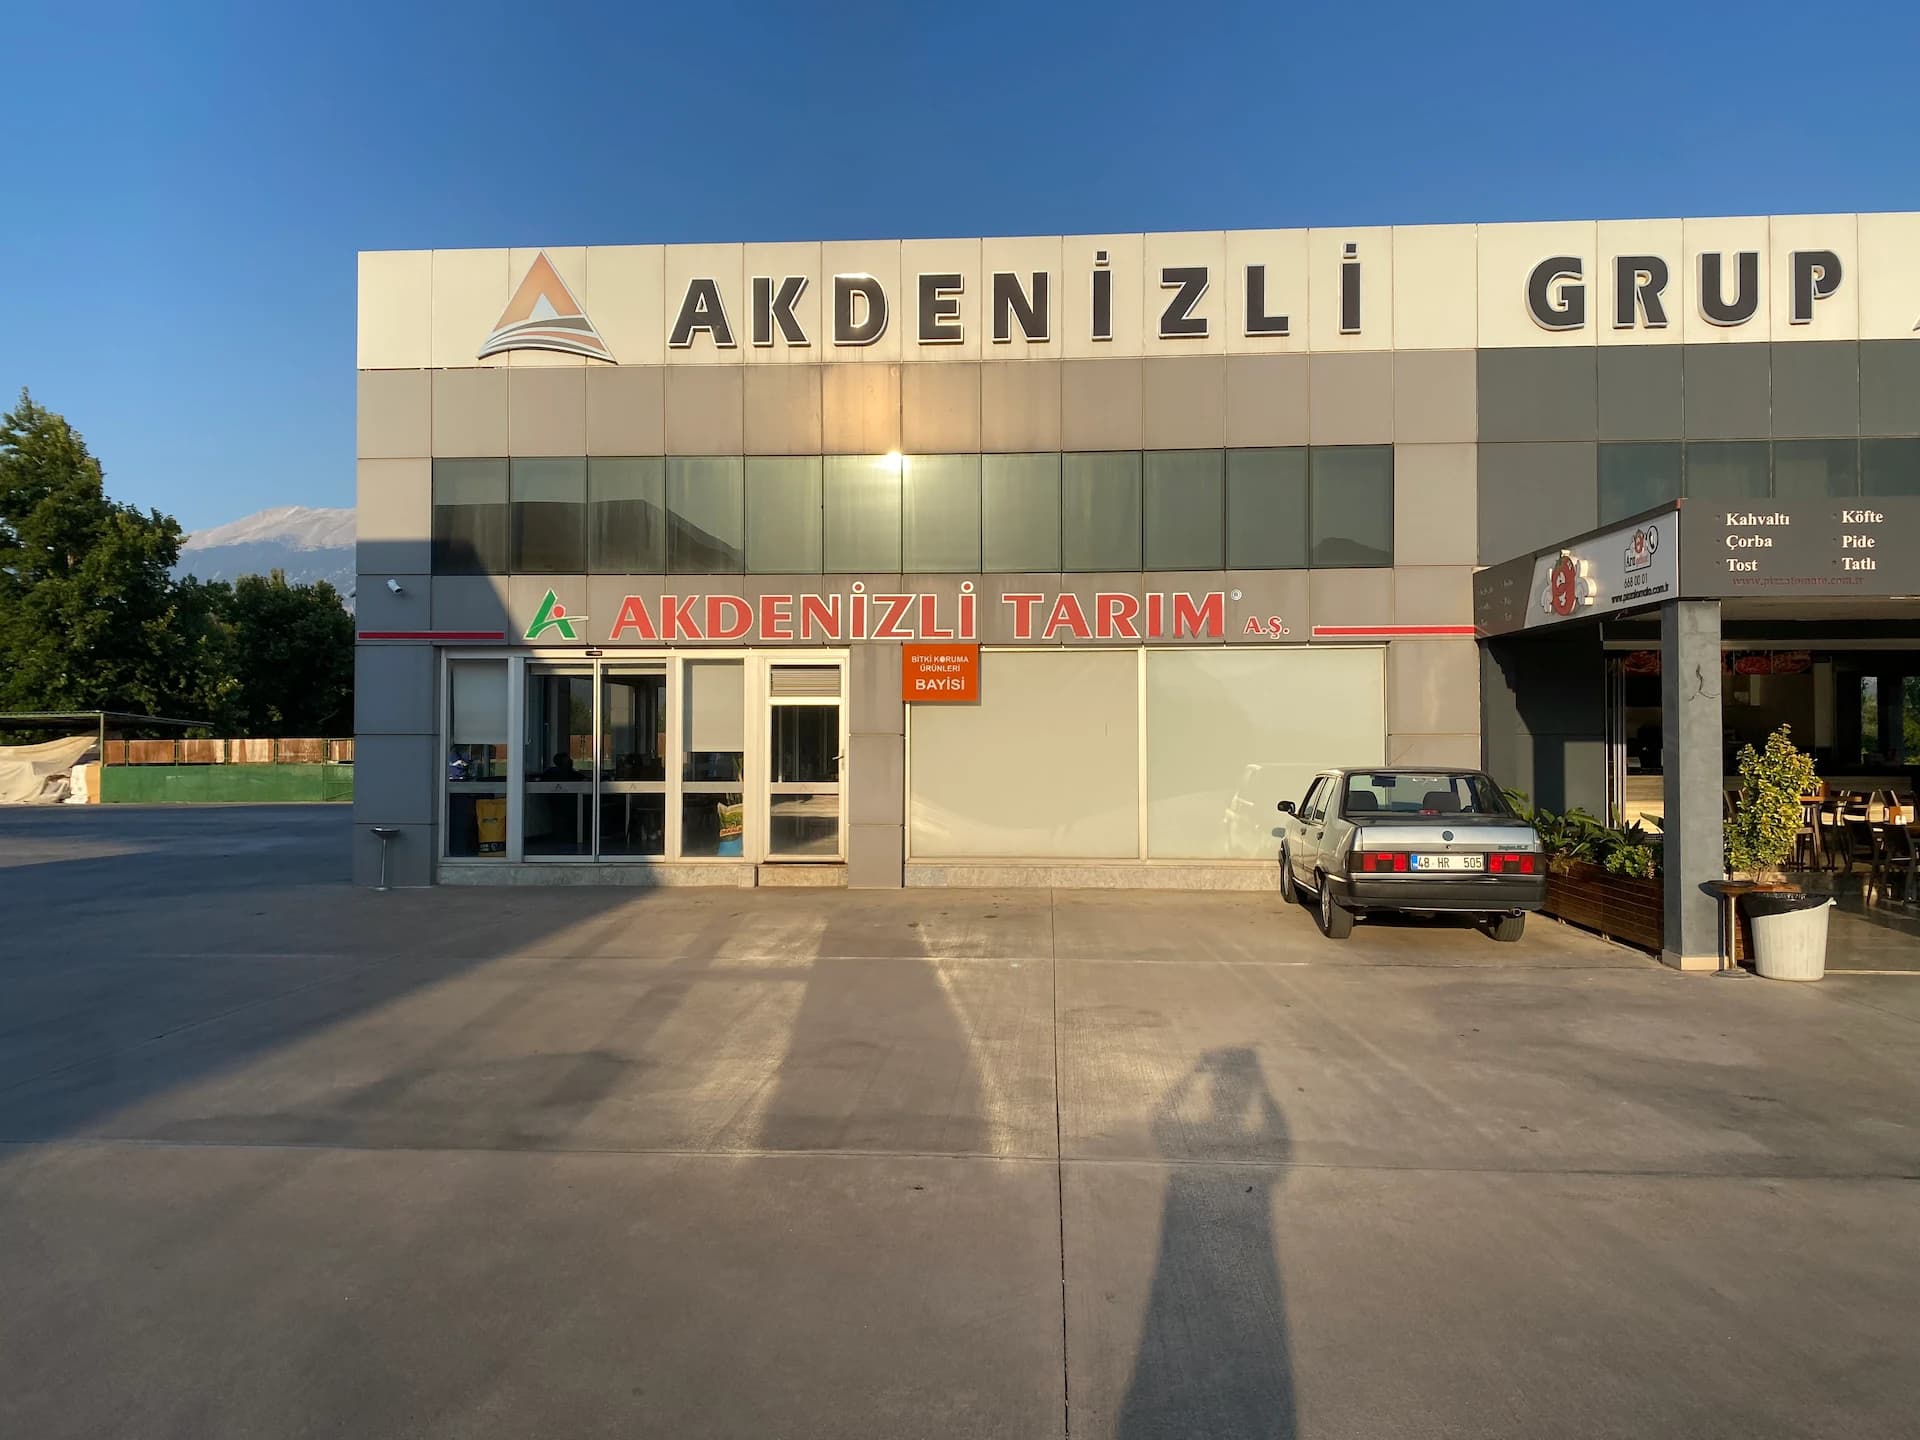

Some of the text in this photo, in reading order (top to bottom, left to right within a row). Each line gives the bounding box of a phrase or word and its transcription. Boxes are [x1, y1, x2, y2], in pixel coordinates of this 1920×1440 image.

[668, 242, 1844, 350] AKDENİZLİ GRUP
[1726, 512, 1790, 526] Kahvaltı
[1841, 509, 1885, 524] Köfte
[1726, 534, 1773, 550] Çorba
[1842, 534, 1876, 549] Pide
[1727, 557, 1759, 572] Tost
[1842, 556, 1876, 570] Tatlı
[608, 580, 1291, 641] AKDENİZLİ TARIM A.Ş.
[911, 654, 969, 663] BİTKİ KORUMA
[920, 664, 960, 672] ÜRÜNLERİ
[915, 676, 965, 690] BAYİSİ
[1418, 857, 1482, 868] 48 HR 505
